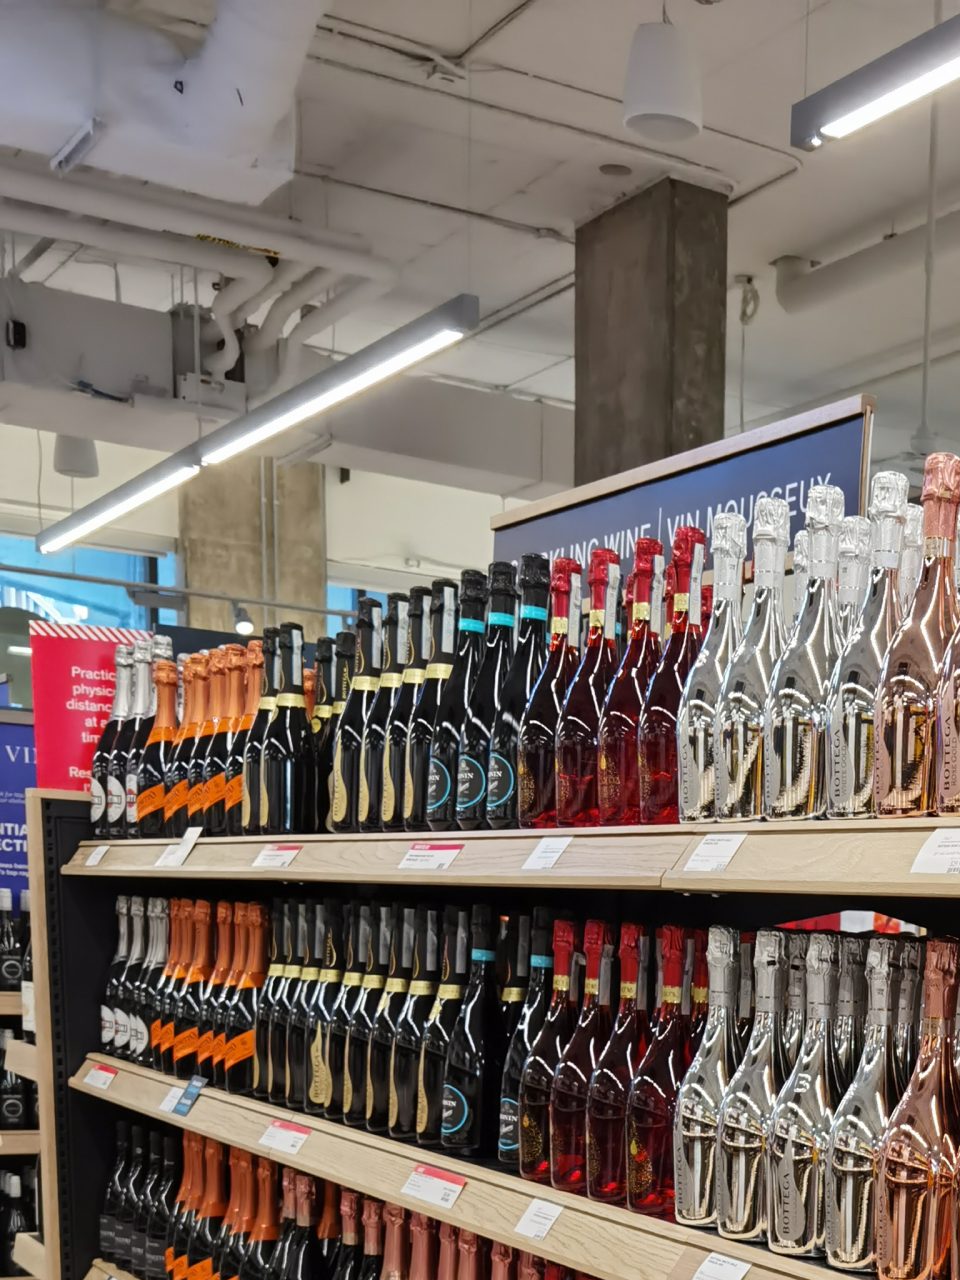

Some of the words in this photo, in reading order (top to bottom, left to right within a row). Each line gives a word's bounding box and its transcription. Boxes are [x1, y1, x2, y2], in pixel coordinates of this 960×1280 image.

[85, 717, 98, 728] at
[943, 716, 952, 791] BOTTEGA
[834, 729, 842, 797] BOTTEGA
[782, 1172, 791, 1234] BOTTEGA
